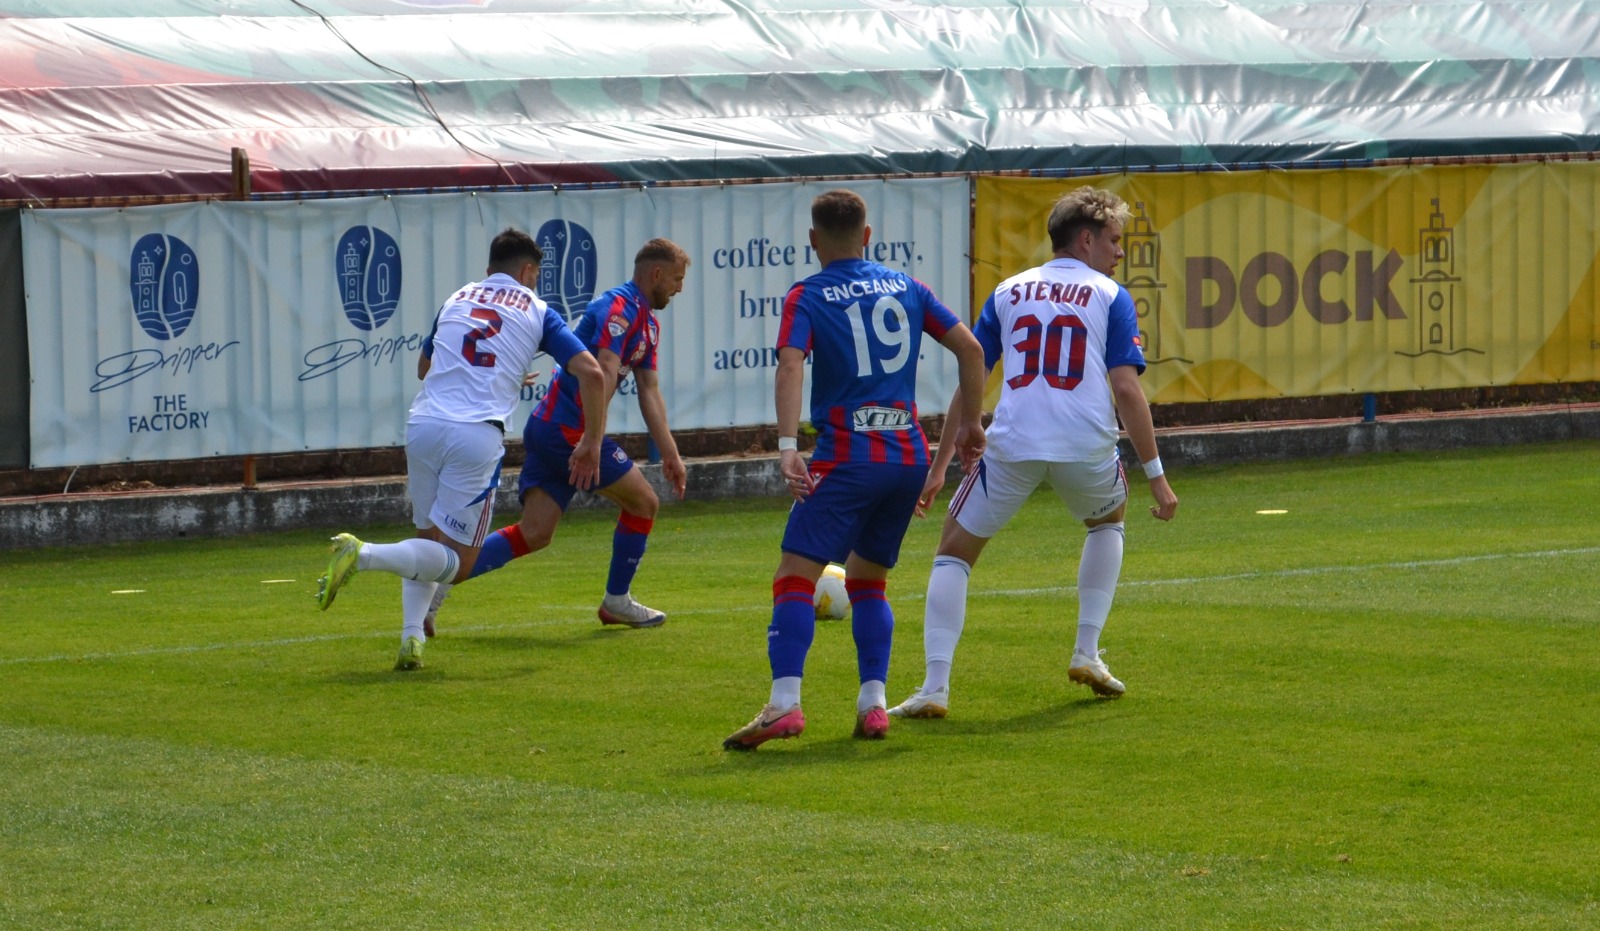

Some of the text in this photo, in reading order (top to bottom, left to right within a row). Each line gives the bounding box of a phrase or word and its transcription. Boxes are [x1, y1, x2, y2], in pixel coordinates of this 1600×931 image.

[712, 237, 924, 269] coffee rtery,
[822, 278, 909, 303] ENCEANU
[1009, 280, 1094, 309] STEAUA
[1184, 246, 1409, 330] DOCK
[461, 307, 503, 368] 2
[843, 295, 911, 377] 19
[1006, 313, 1089, 392] 30
[89, 340, 240, 393] Dripper
[127, 410, 210, 434] FACTORY
[153, 393, 188, 413] THE
